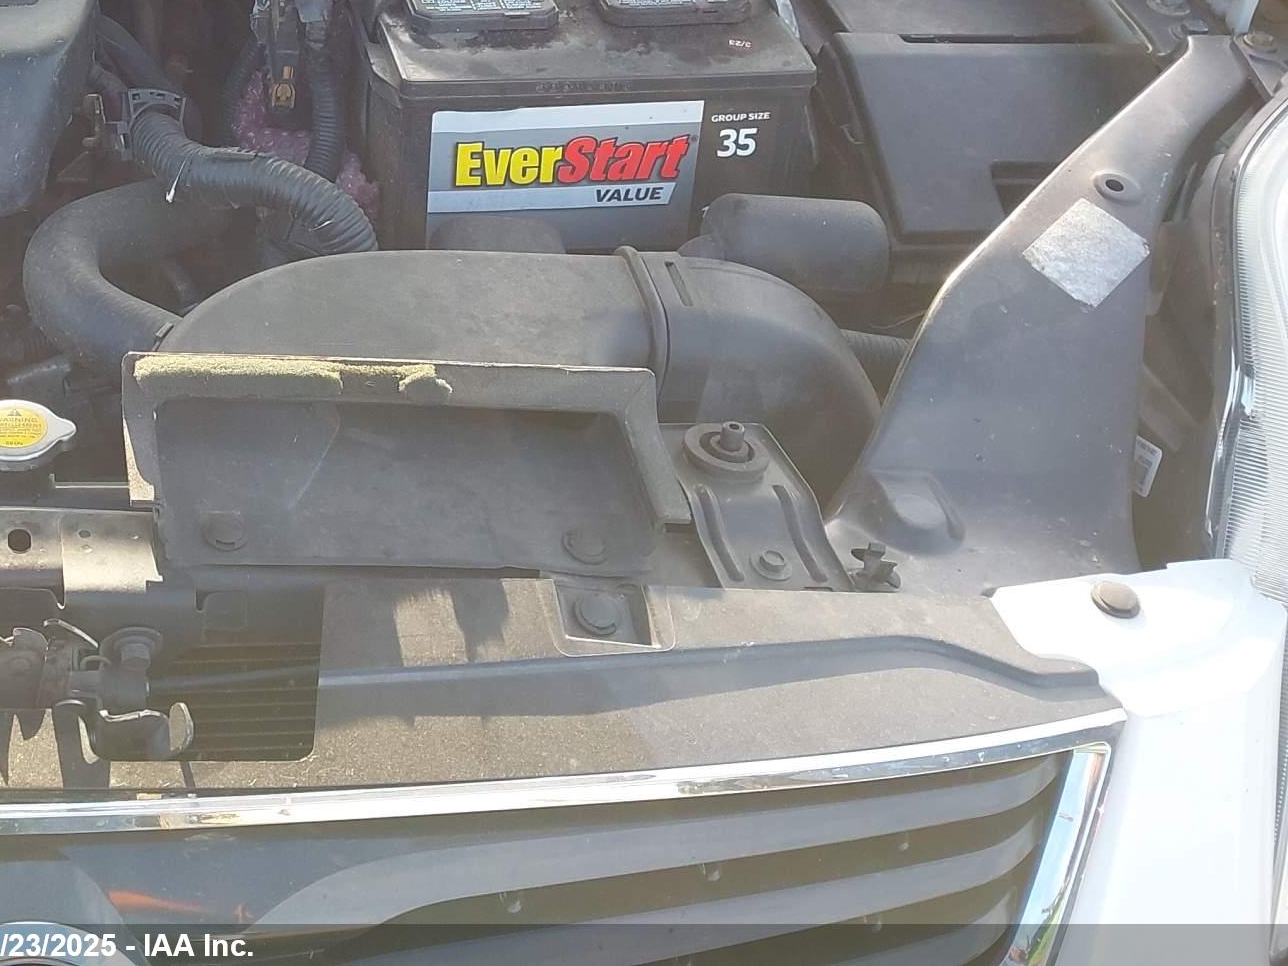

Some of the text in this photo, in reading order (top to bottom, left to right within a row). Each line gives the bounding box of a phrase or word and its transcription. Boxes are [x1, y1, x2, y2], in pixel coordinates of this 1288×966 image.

[711, 111, 771, 123] GROUP SIZE
[716, 127, 758, 158] 35
[454, 134, 691, 186] EverStart
[594, 187, 663, 203] VALUE
